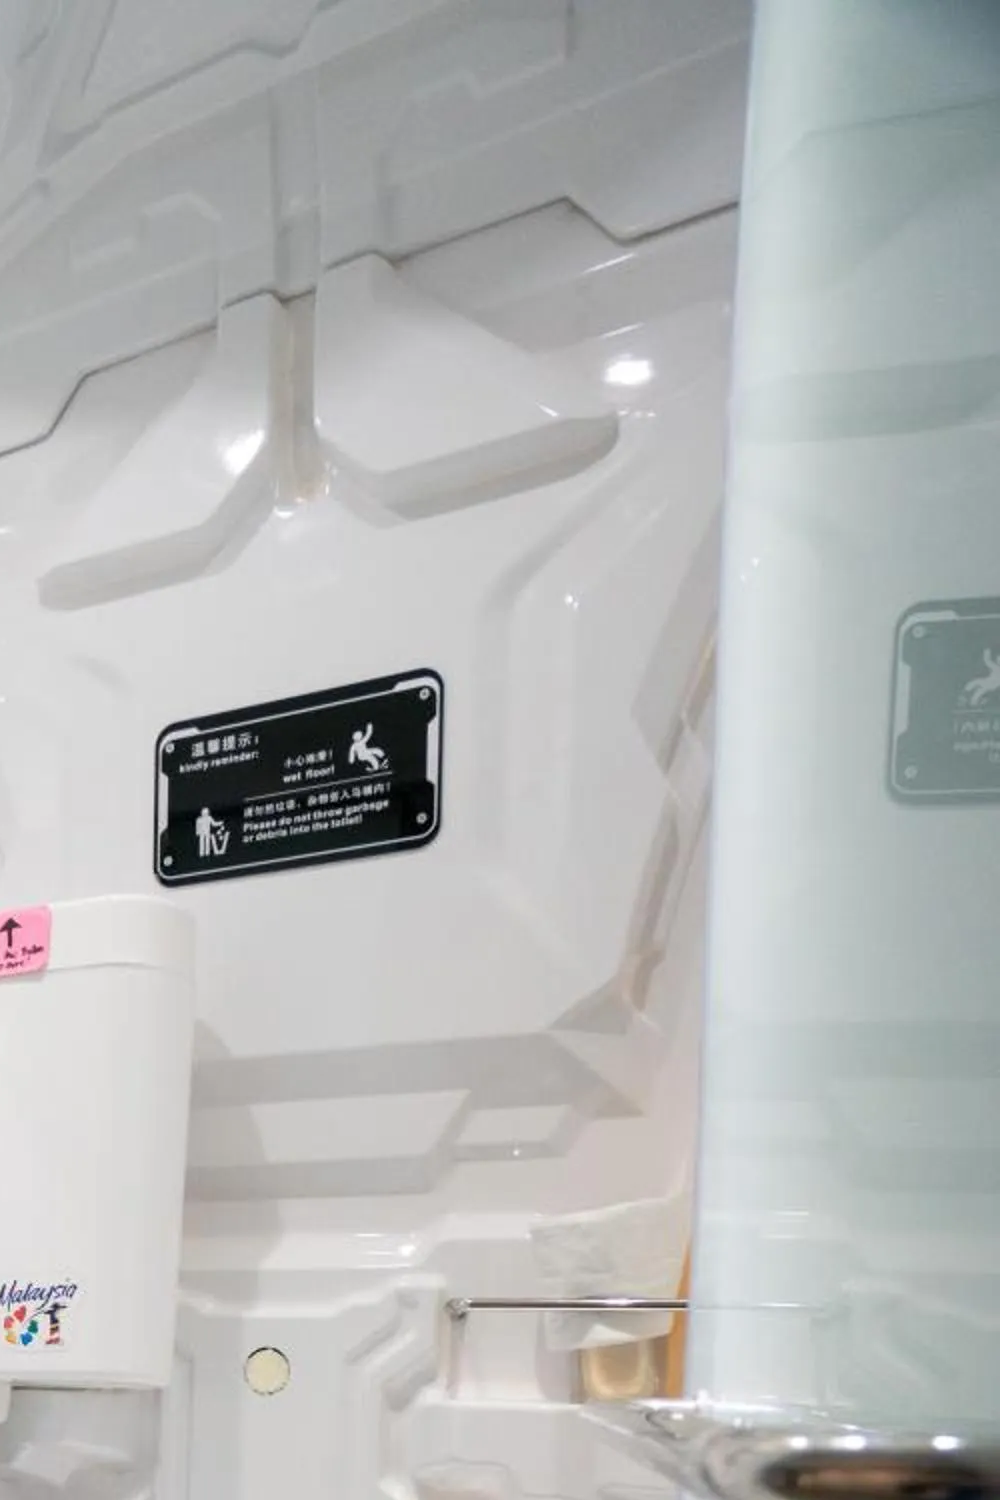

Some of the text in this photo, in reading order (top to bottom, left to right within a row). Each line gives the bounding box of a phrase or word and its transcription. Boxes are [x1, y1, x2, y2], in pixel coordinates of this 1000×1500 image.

[179, 751, 260, 774] kindly reminder:
[283, 764, 336, 783] wet floor!
[242, 813, 363, 843] or debris into the toilet!
[243, 799, 389, 833] Please do not throw garbage
